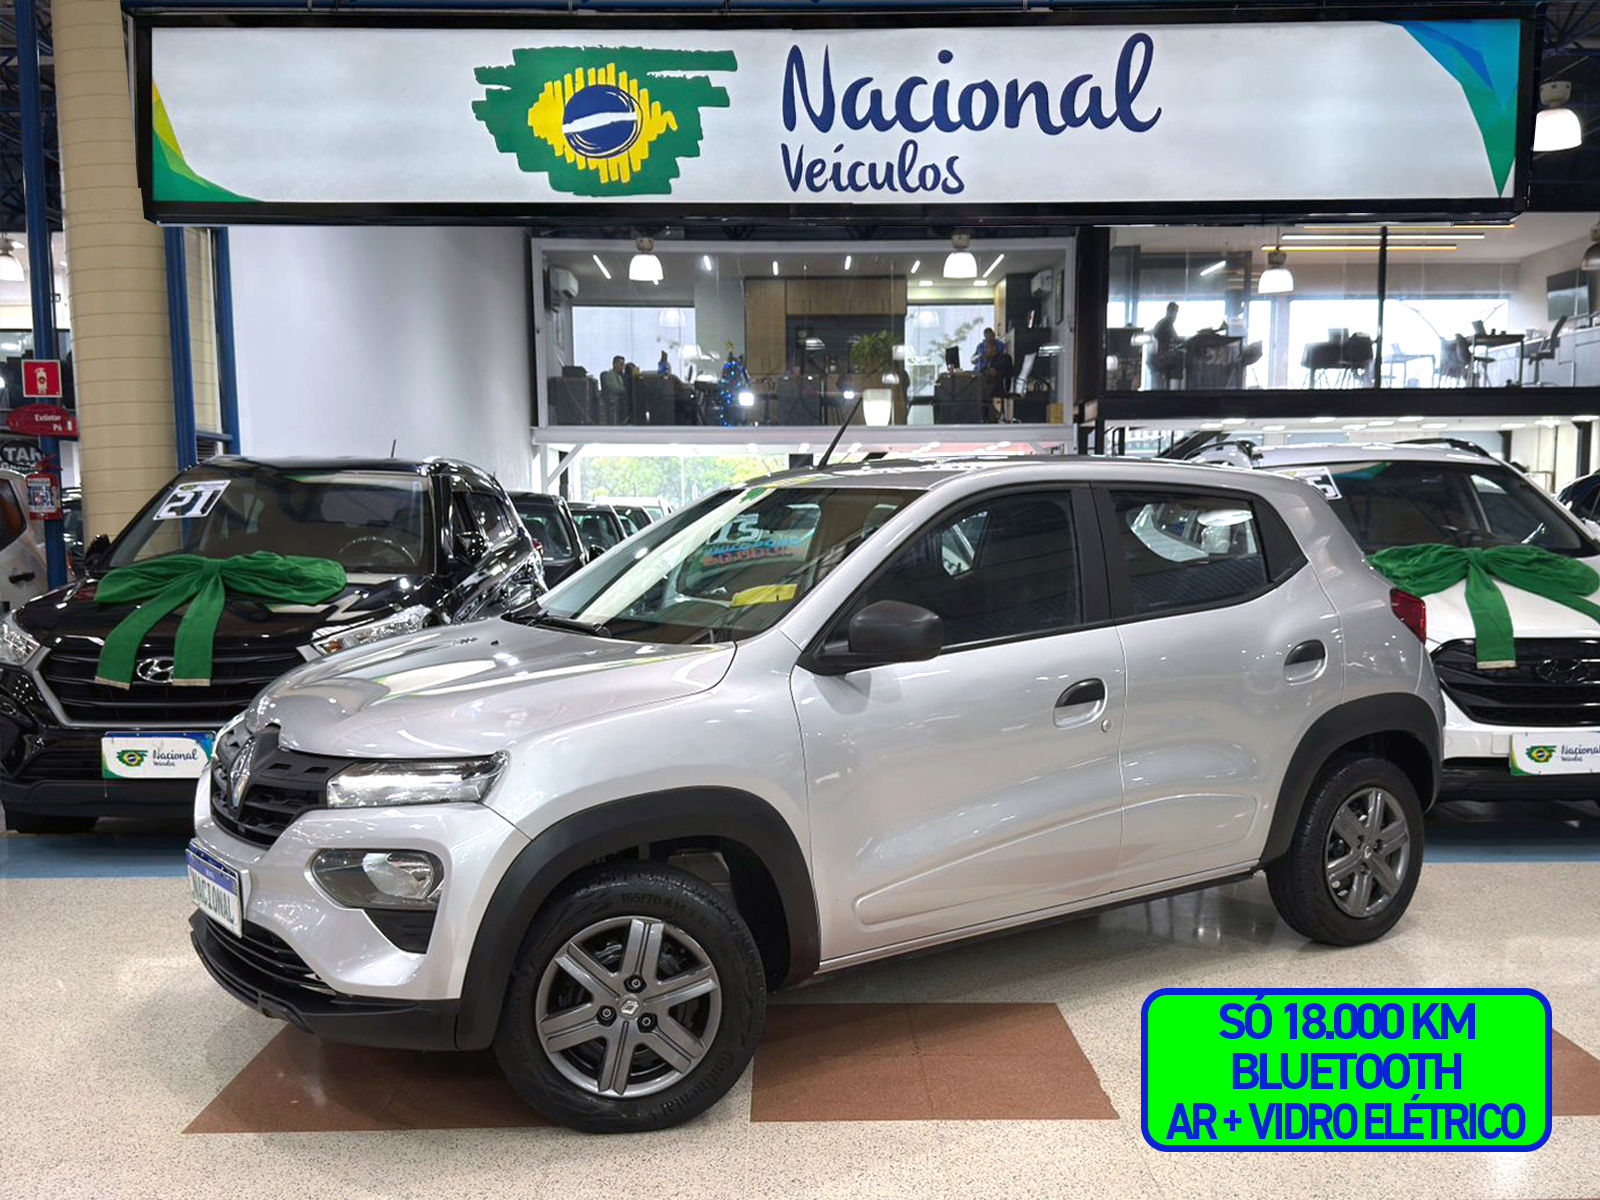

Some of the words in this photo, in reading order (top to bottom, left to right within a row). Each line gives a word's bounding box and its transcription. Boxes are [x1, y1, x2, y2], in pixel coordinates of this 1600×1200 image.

[782, 33, 1162, 135] Nacional
[781, 139, 964, 194] Veículos
[159, 490, 212, 517] 21
[153, 749, 197, 760] Nacional
